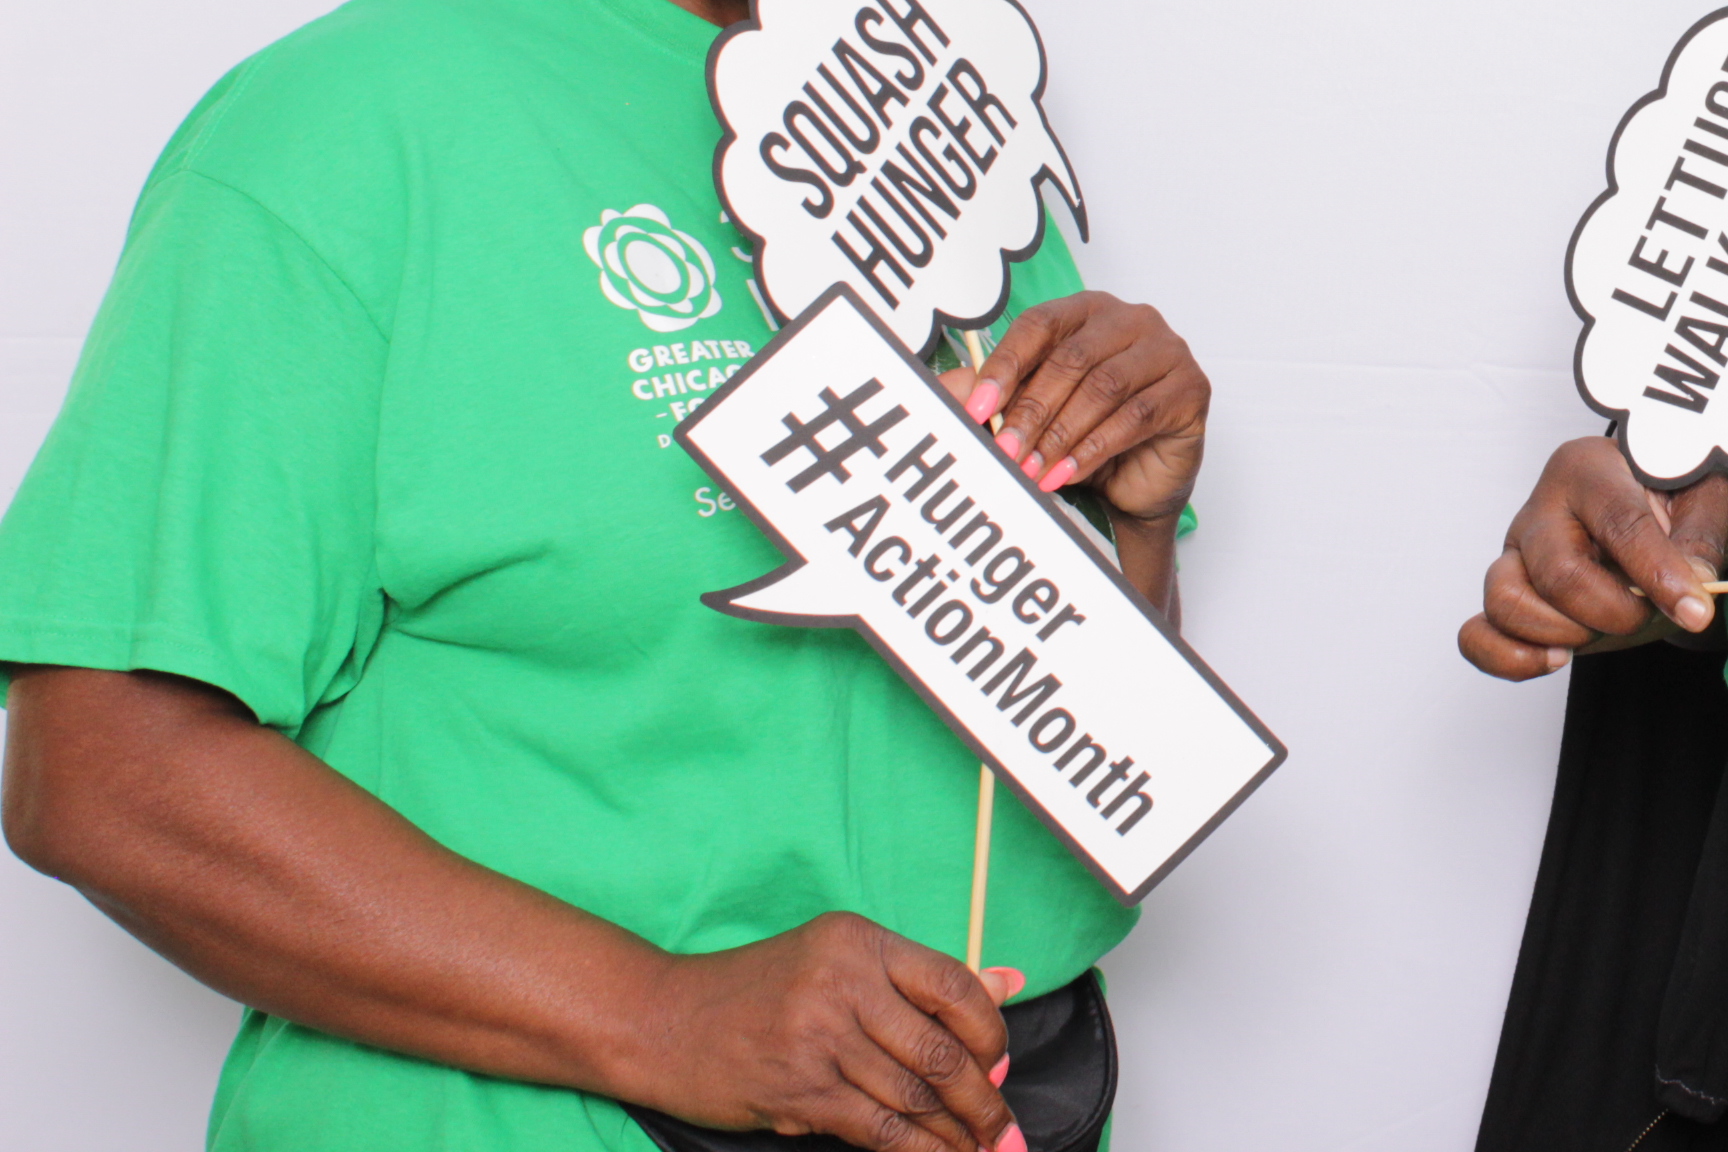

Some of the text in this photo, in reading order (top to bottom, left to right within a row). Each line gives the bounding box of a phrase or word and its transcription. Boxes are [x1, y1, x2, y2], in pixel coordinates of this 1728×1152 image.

[830, 56, 1018, 311] HUNGER
[628, 339, 756, 373] GREATER
[632, 364, 743, 400] CHICA
[823, 494, 1155, 837] ActionMonth
